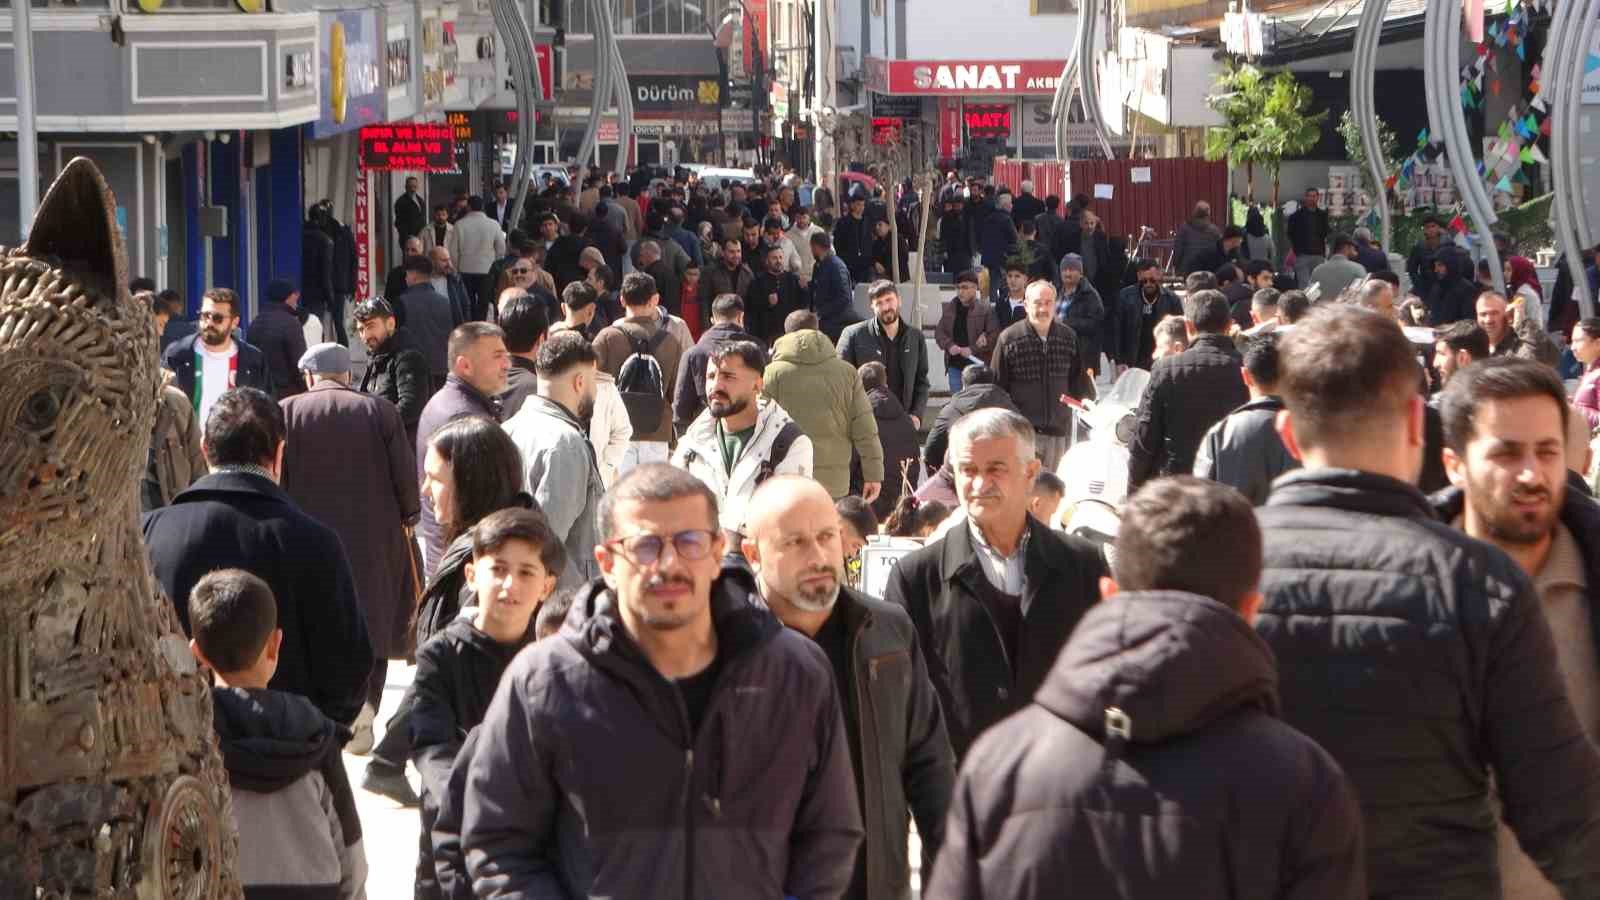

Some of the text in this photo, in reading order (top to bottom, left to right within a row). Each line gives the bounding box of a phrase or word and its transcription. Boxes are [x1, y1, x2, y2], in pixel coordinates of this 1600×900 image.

[912, 64, 1021, 89] SANAT
[637, 84, 695, 102] Dürüm
[357, 243, 369, 302] SERV
